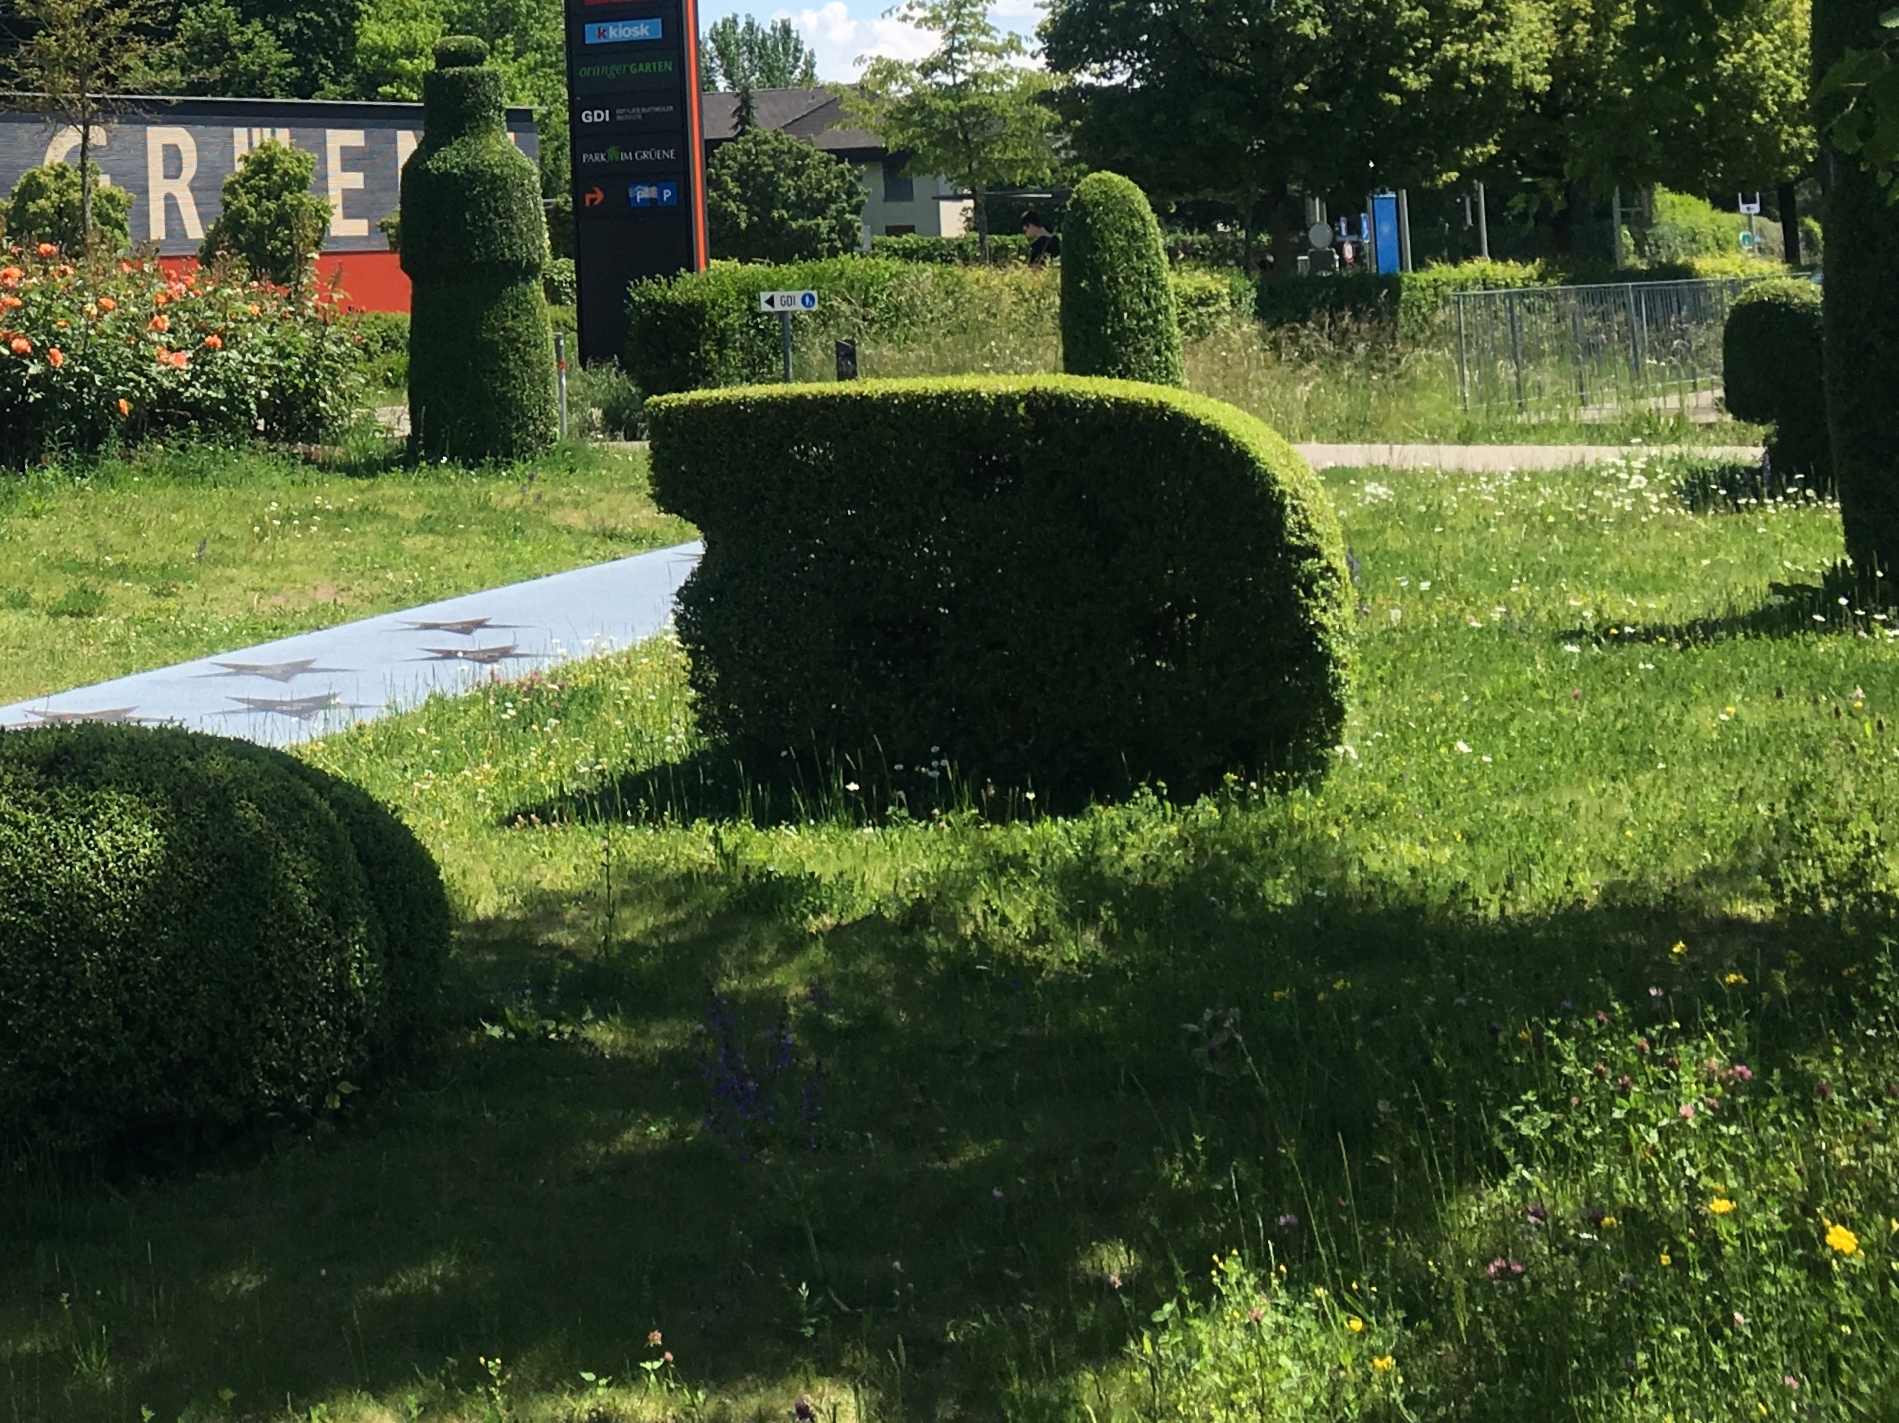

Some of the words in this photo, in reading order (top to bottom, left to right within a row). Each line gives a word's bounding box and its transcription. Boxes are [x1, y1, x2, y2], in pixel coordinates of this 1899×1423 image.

[608, 22, 650, 39] kiosk
[581, 109, 611, 123] GDI
[582, 152, 608, 163] PARK
[620, 150, 633, 161] IM
[634, 147, 677, 162] GRÜENE
[663, 188, 672, 202] P
[779, 294, 797, 308] GDI
